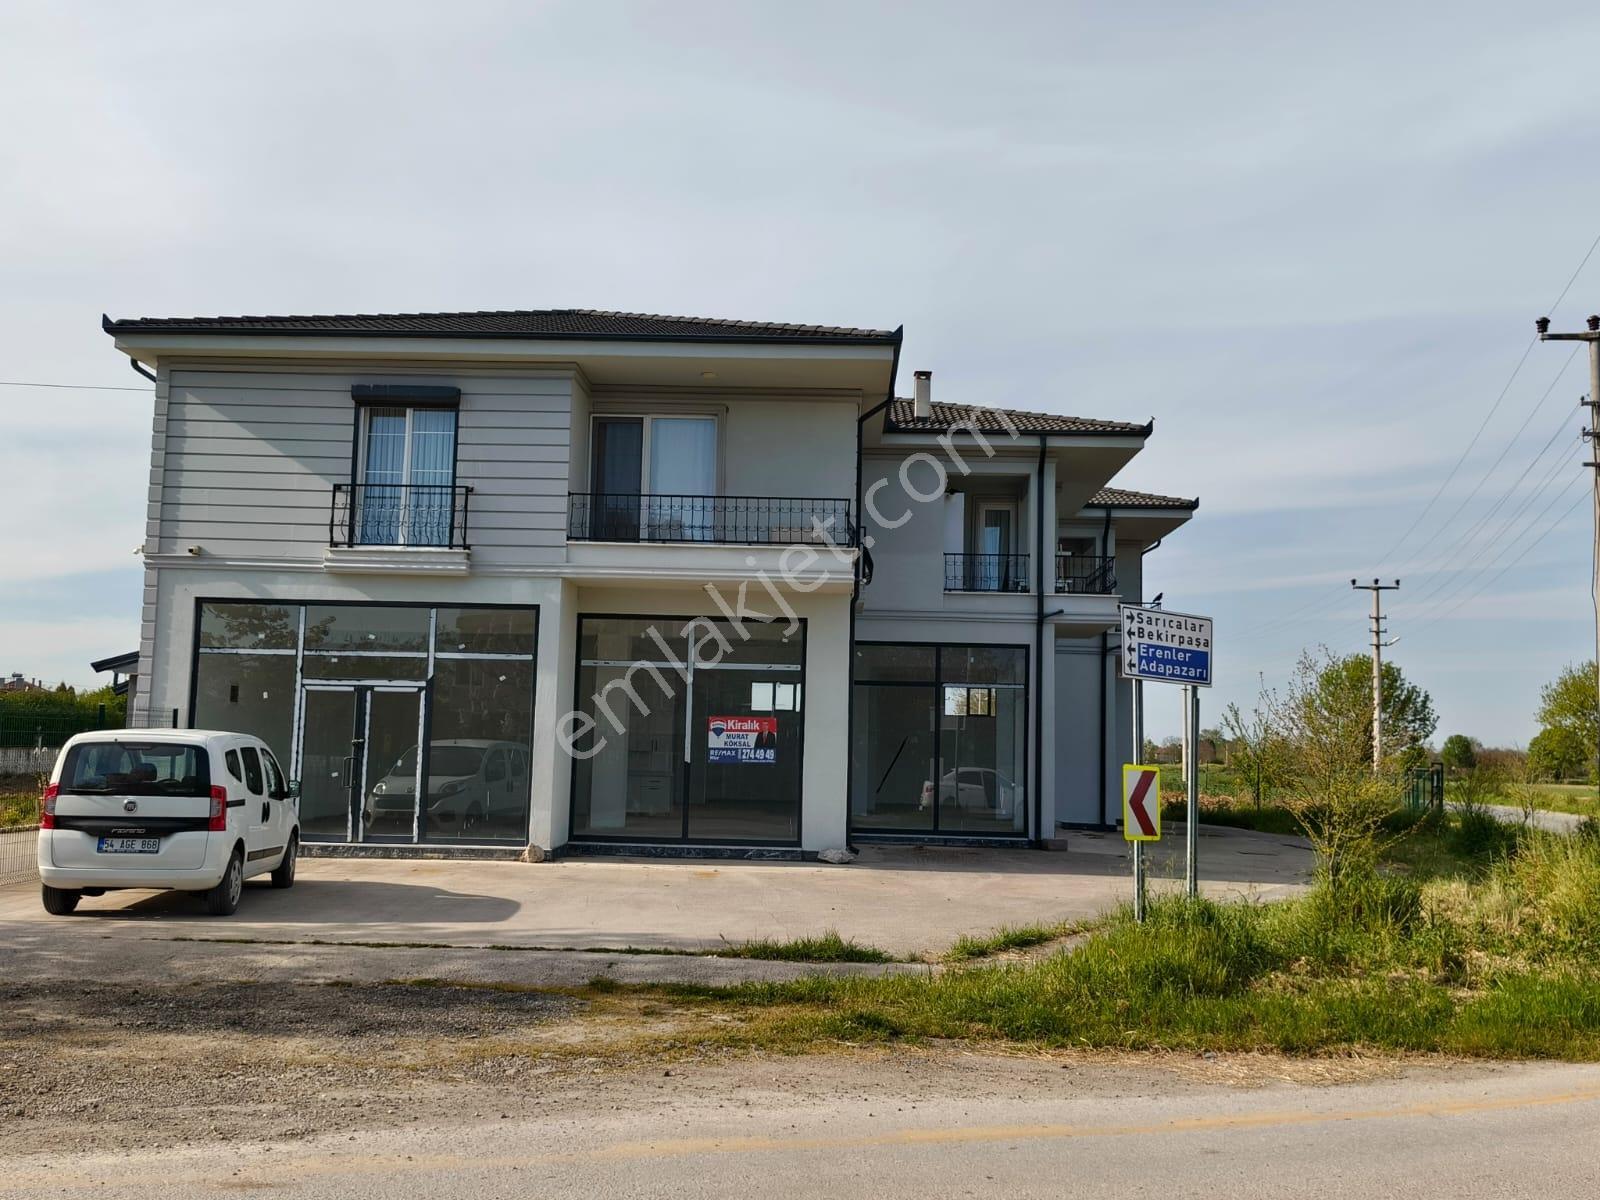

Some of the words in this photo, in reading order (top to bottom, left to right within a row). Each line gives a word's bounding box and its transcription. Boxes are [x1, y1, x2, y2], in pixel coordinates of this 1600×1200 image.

[1136, 612, 1204, 632] Sarıcalar
[1137, 627, 1209, 648] Bekirpaşa
[1140, 644, 1192, 662] Erenler
[1139, 659, 1206, 678] Adapazarı
[727, 719, 760, 730] Kiralık
[104, 839, 114, 849] 54
[119, 839, 136, 849] AGE
